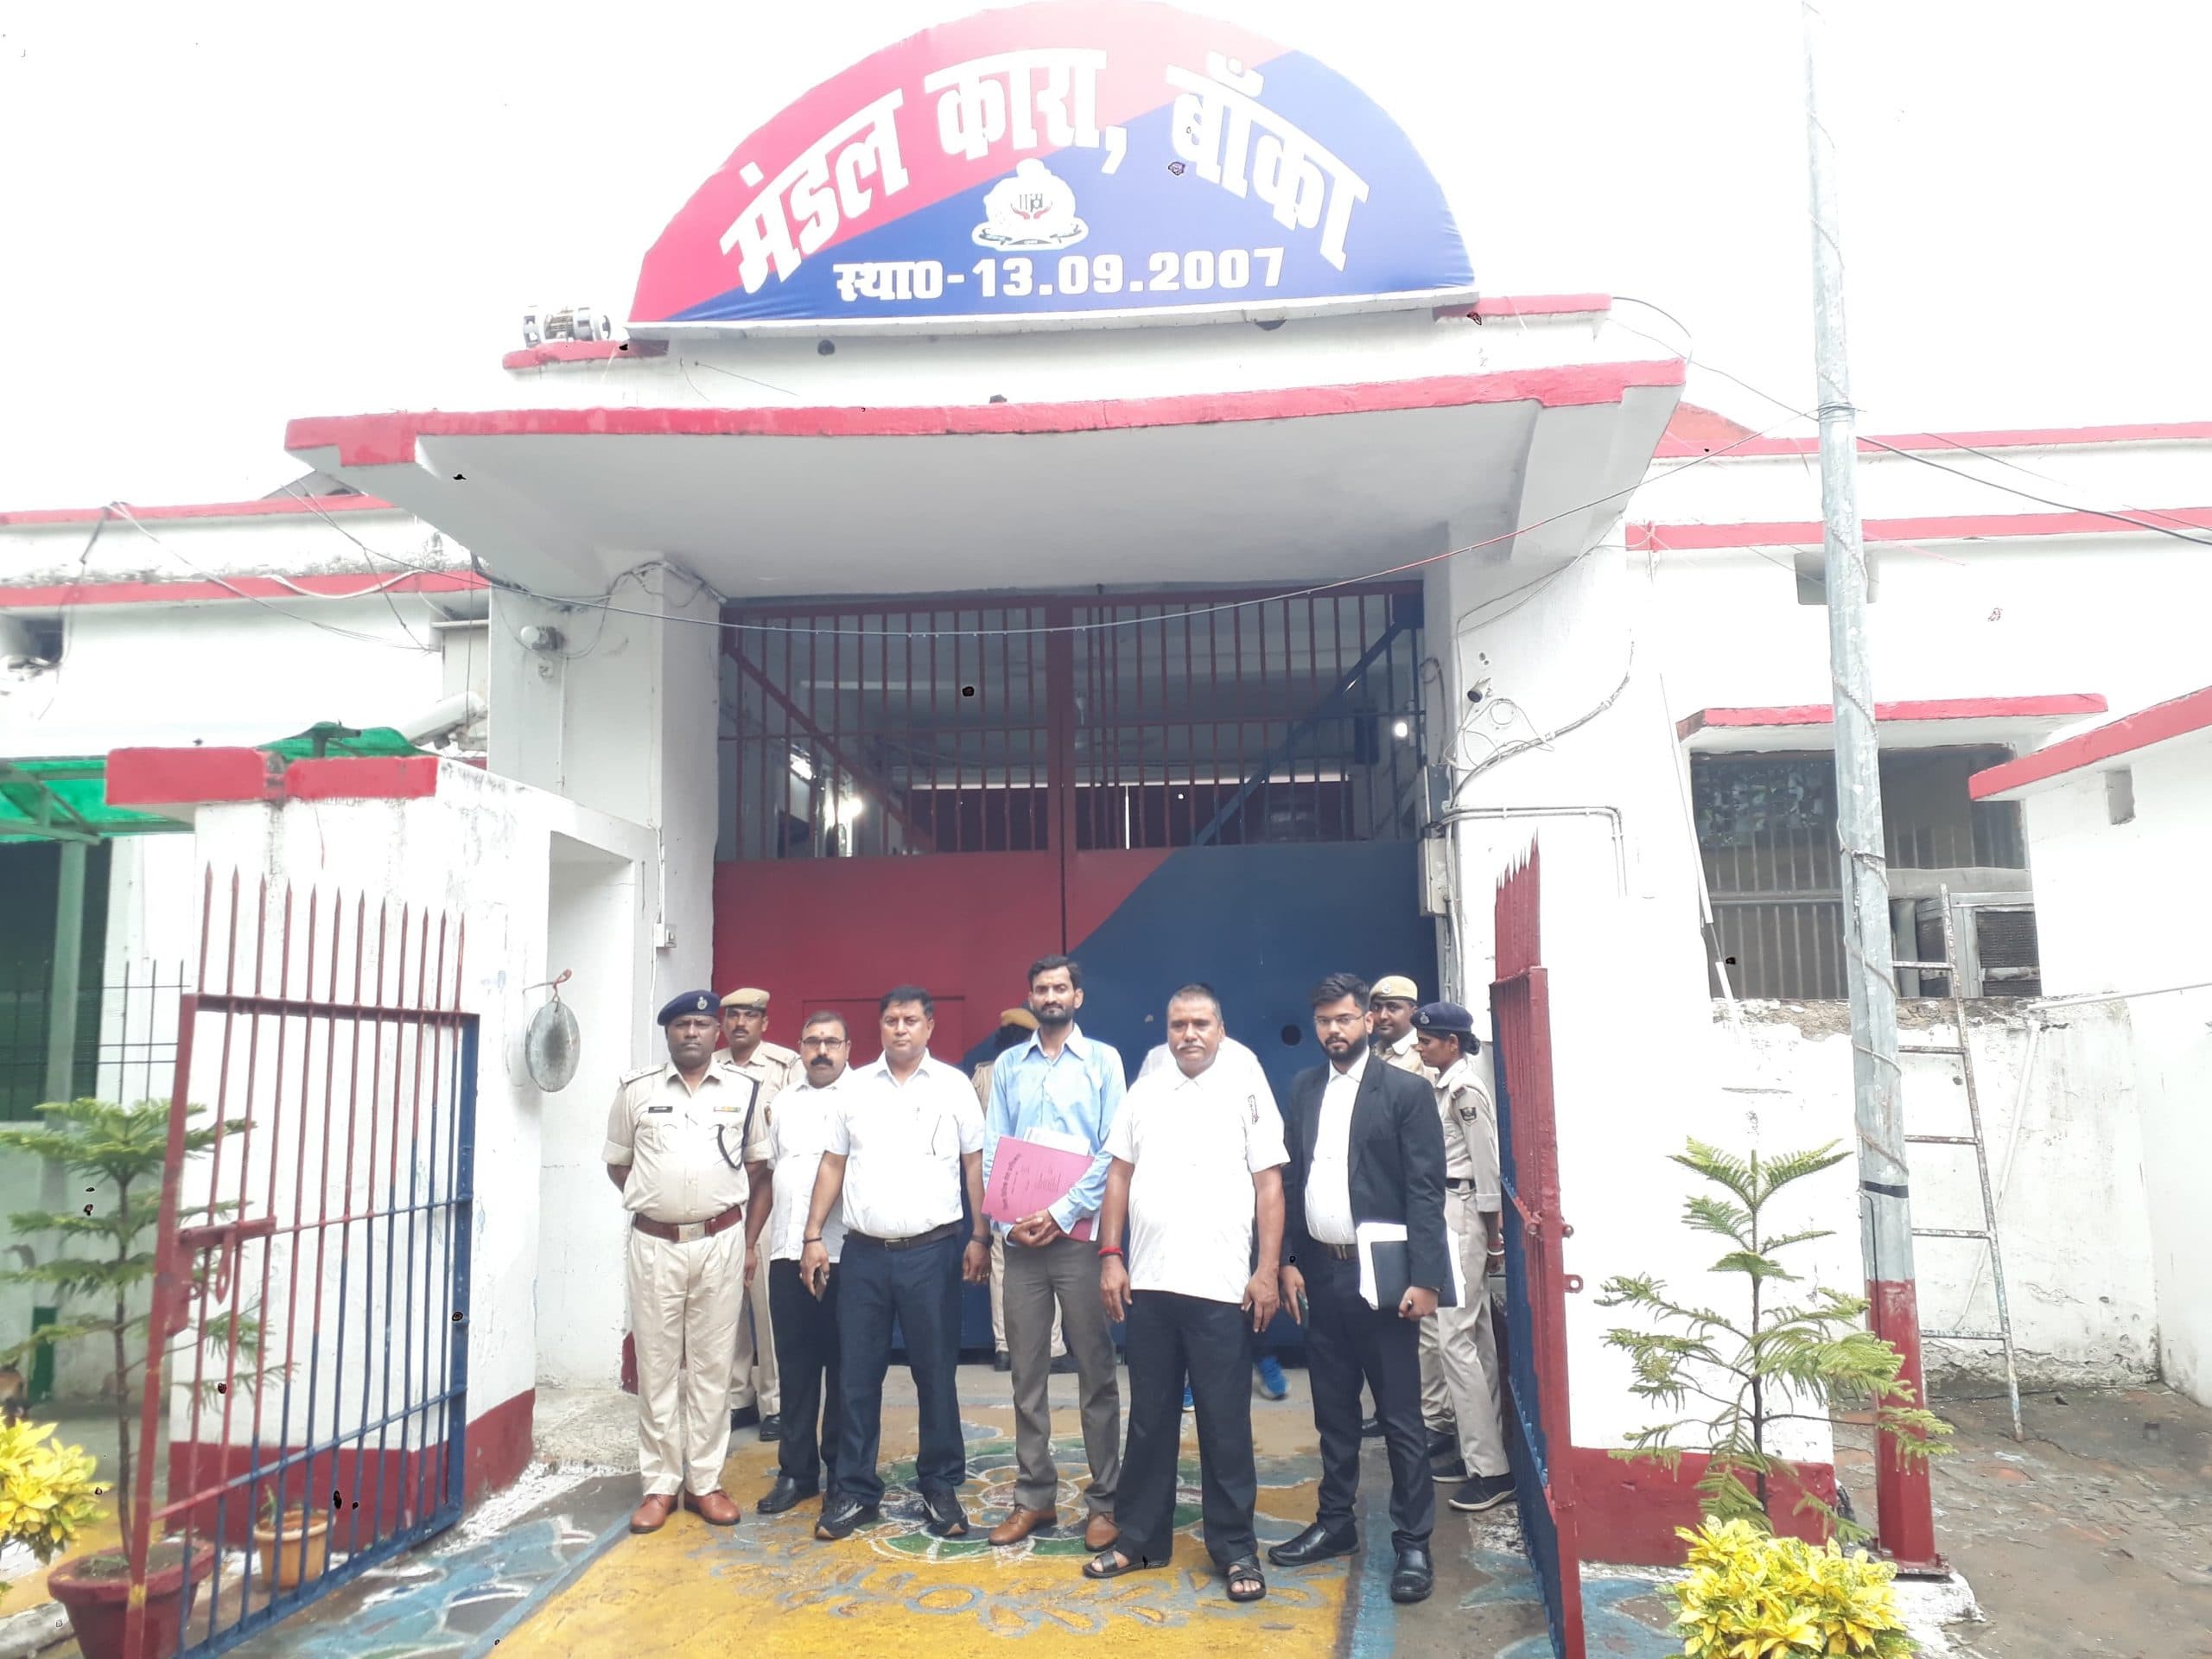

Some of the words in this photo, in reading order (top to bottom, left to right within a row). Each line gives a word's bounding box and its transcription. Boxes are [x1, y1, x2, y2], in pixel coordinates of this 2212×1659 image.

[719, 87, 910, 295] मंडल
[924, 48, 1128, 175] कारा,
[1165, 49, 1370, 273] बाँका
